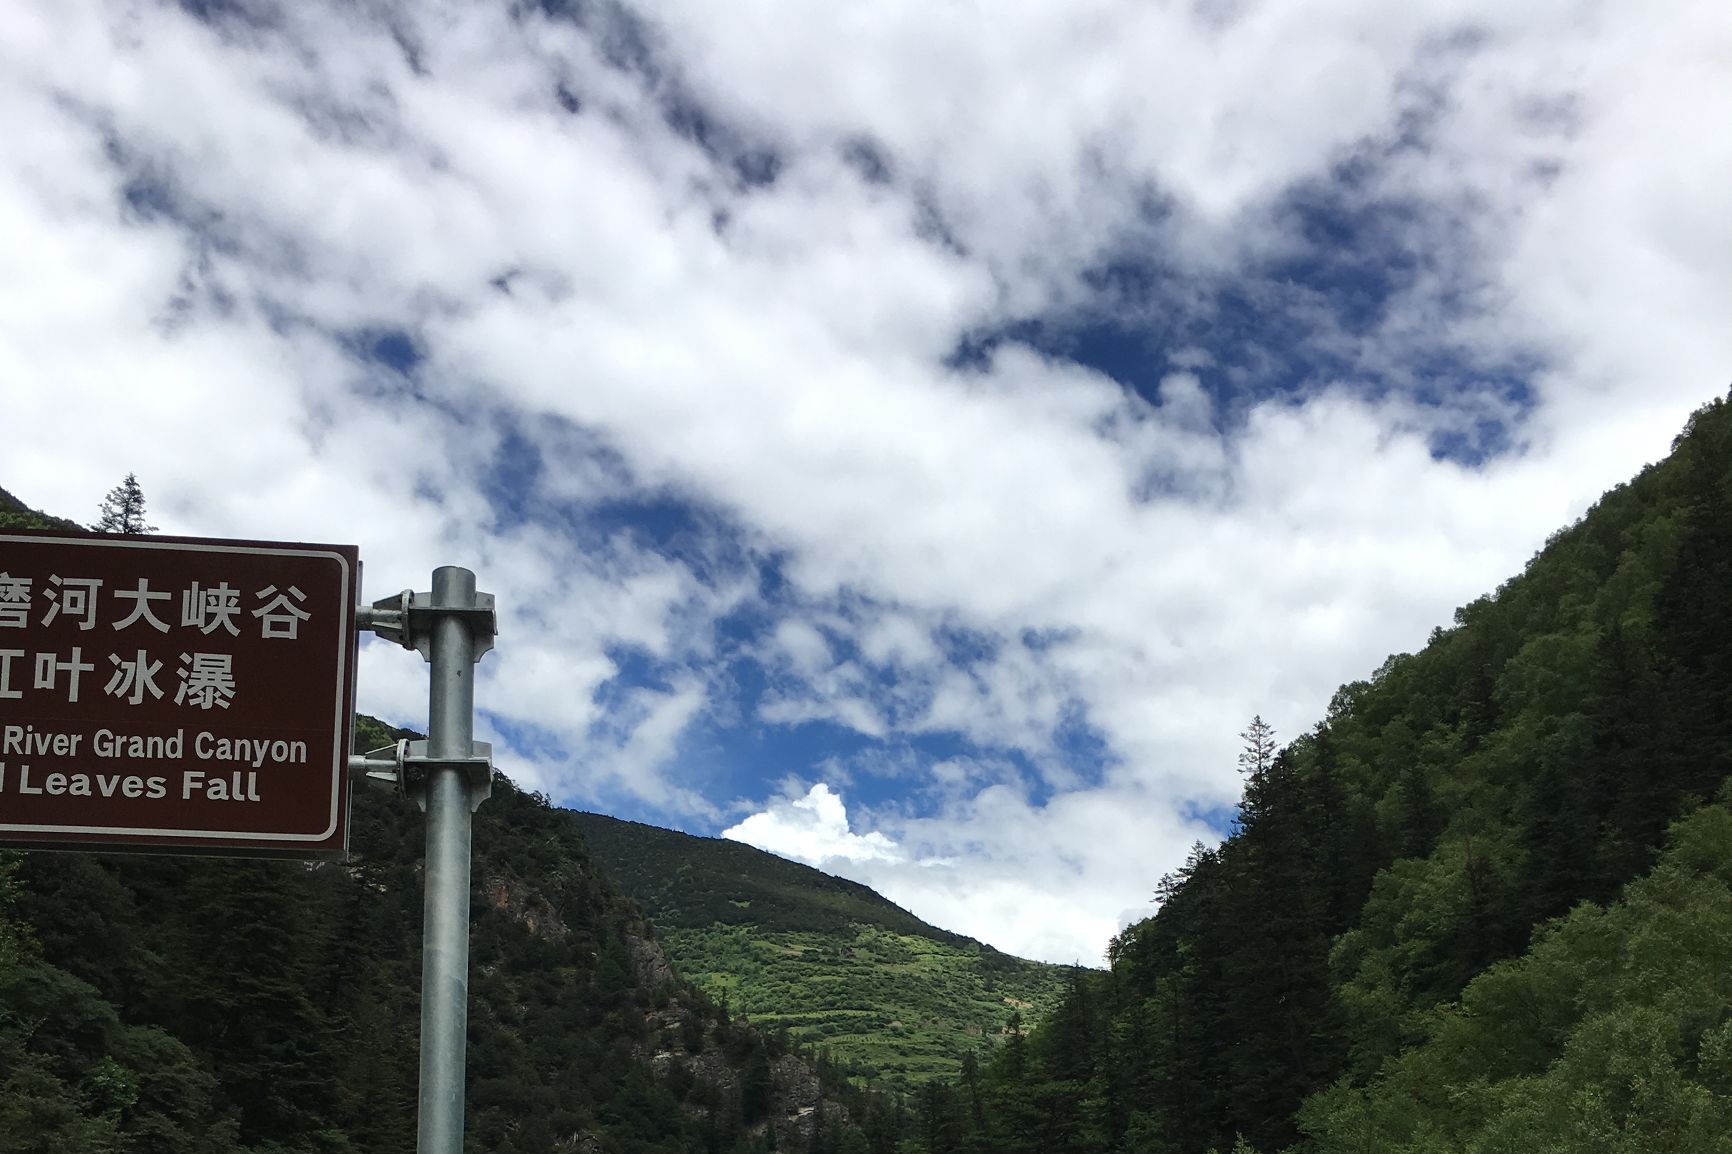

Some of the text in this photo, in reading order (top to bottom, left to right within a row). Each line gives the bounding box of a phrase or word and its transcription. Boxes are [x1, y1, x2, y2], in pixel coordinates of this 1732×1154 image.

[3, 724, 307, 768] River Grand Canyon
[19, 764, 167, 799] Leaves
[182, 770, 261, 802] Fall
